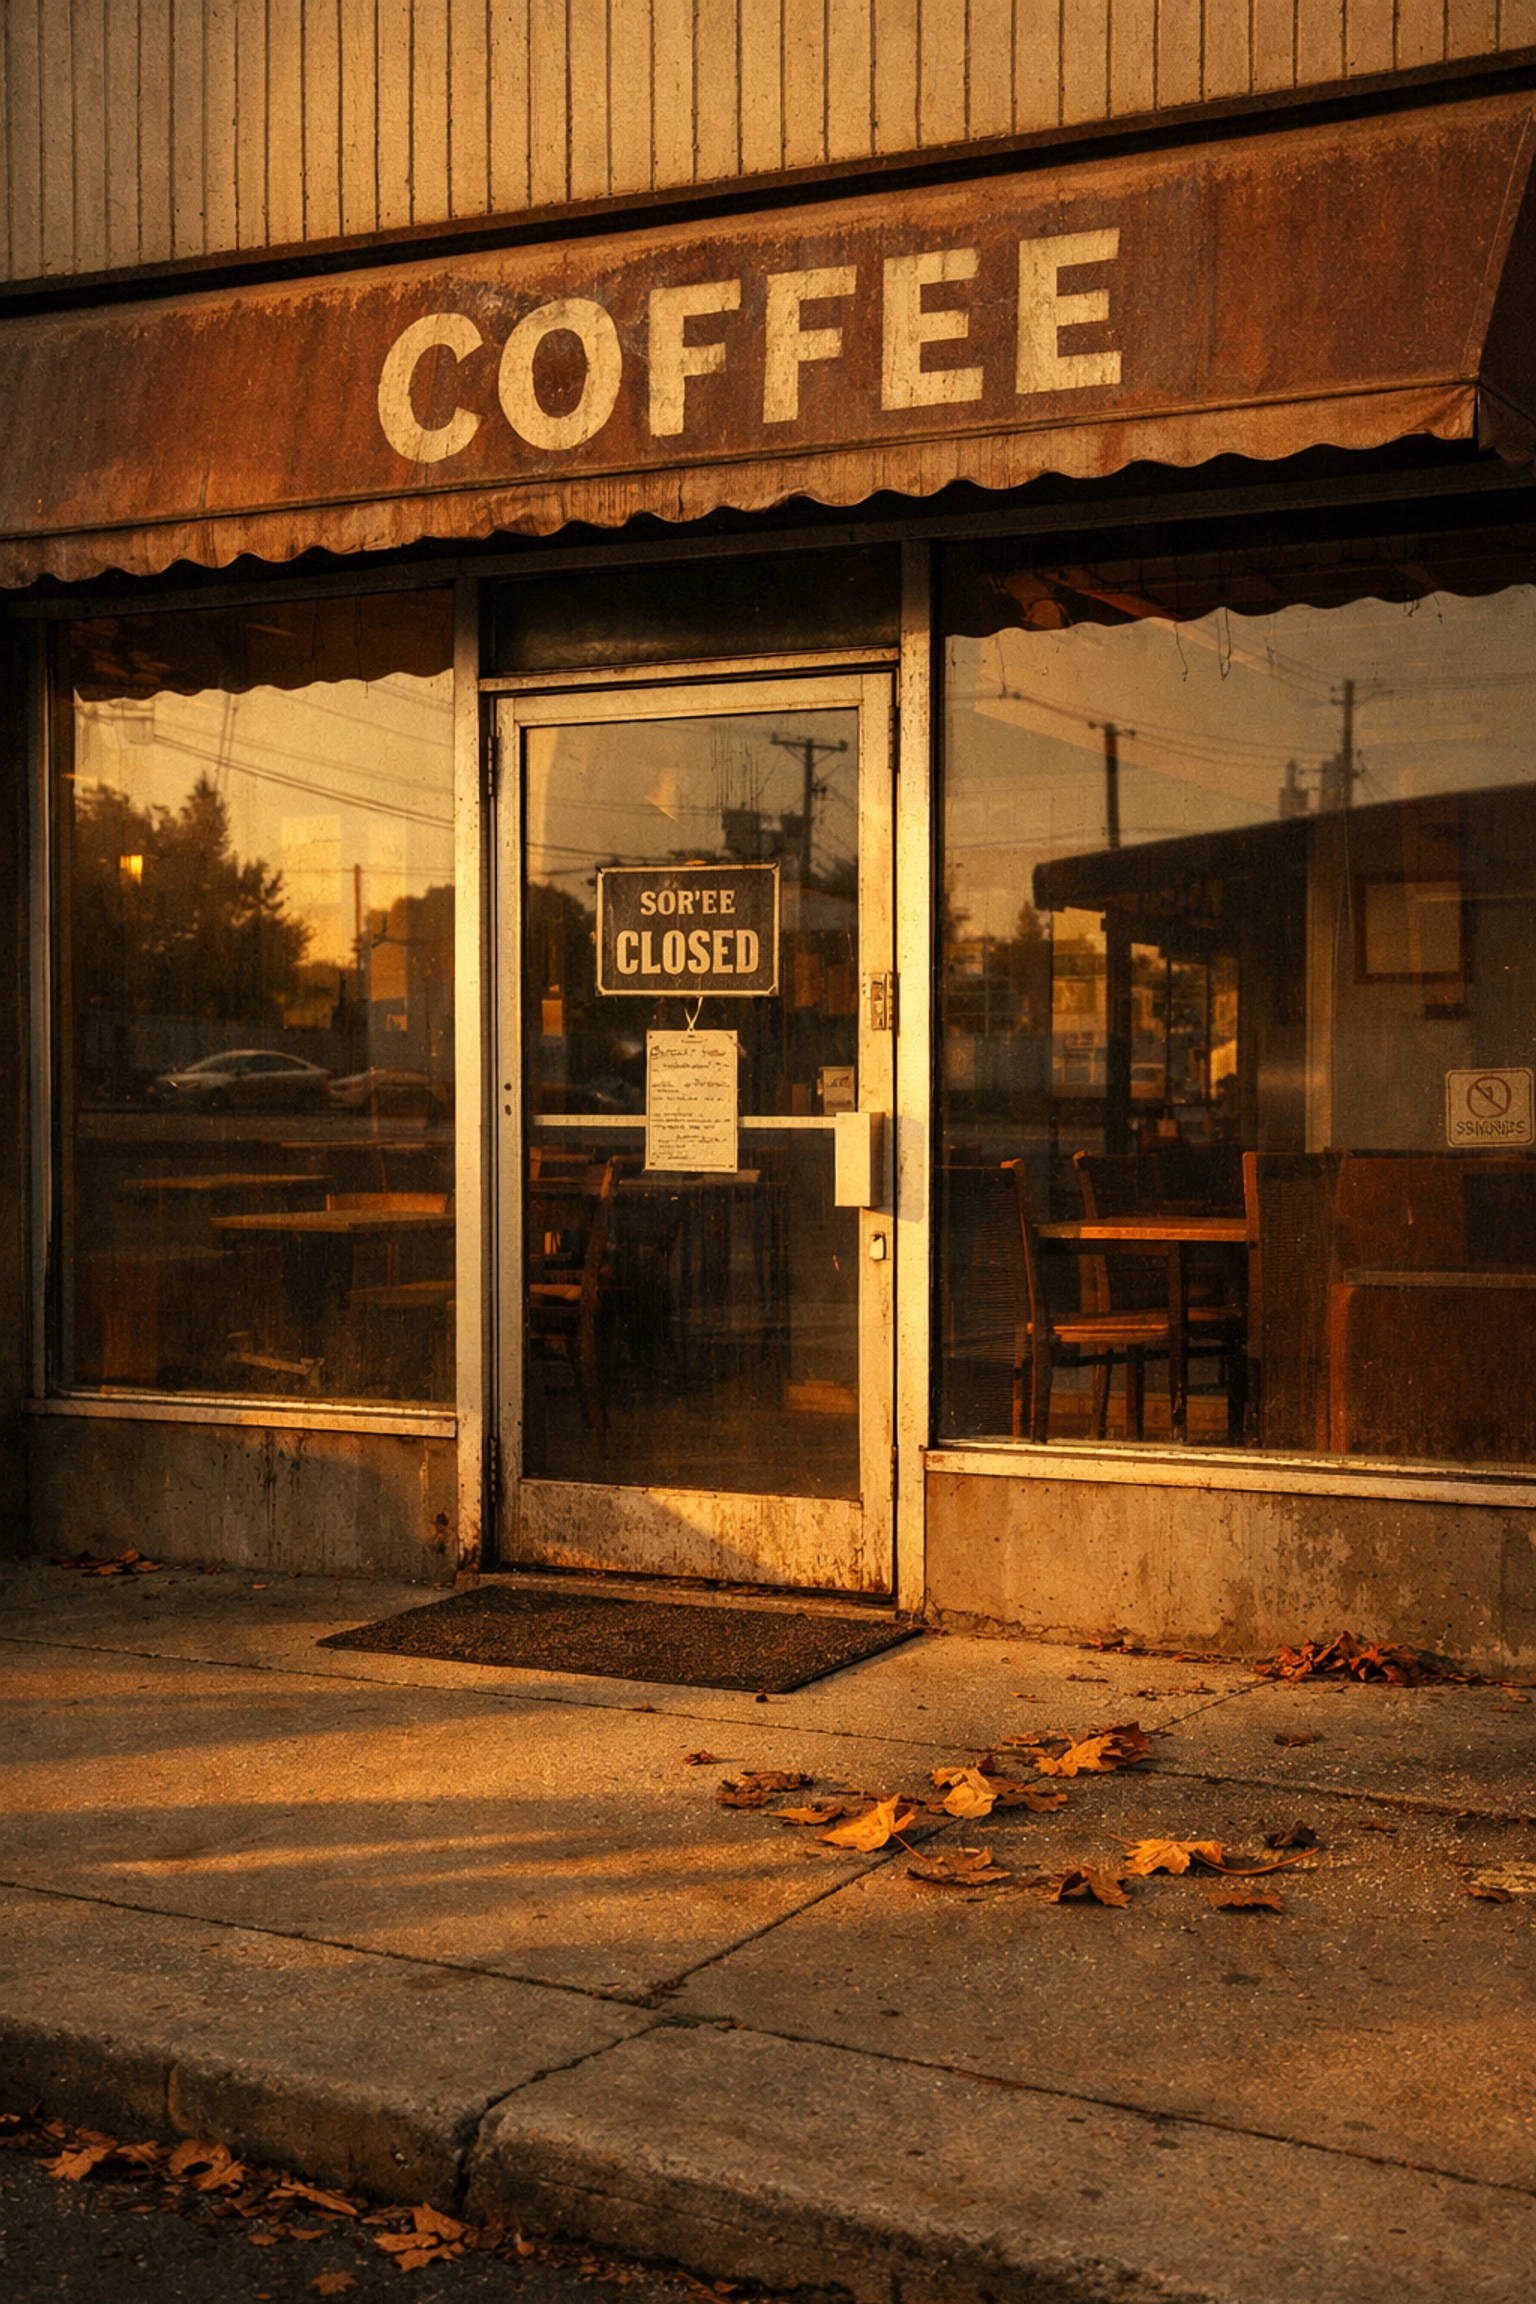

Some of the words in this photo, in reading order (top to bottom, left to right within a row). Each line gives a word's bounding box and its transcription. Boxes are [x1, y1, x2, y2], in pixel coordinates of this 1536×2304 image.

[377, 227, 1122, 463] COFFEE
[640, 889, 736, 916] SOR'EE
[616, 929, 760, 975] CLOSED
